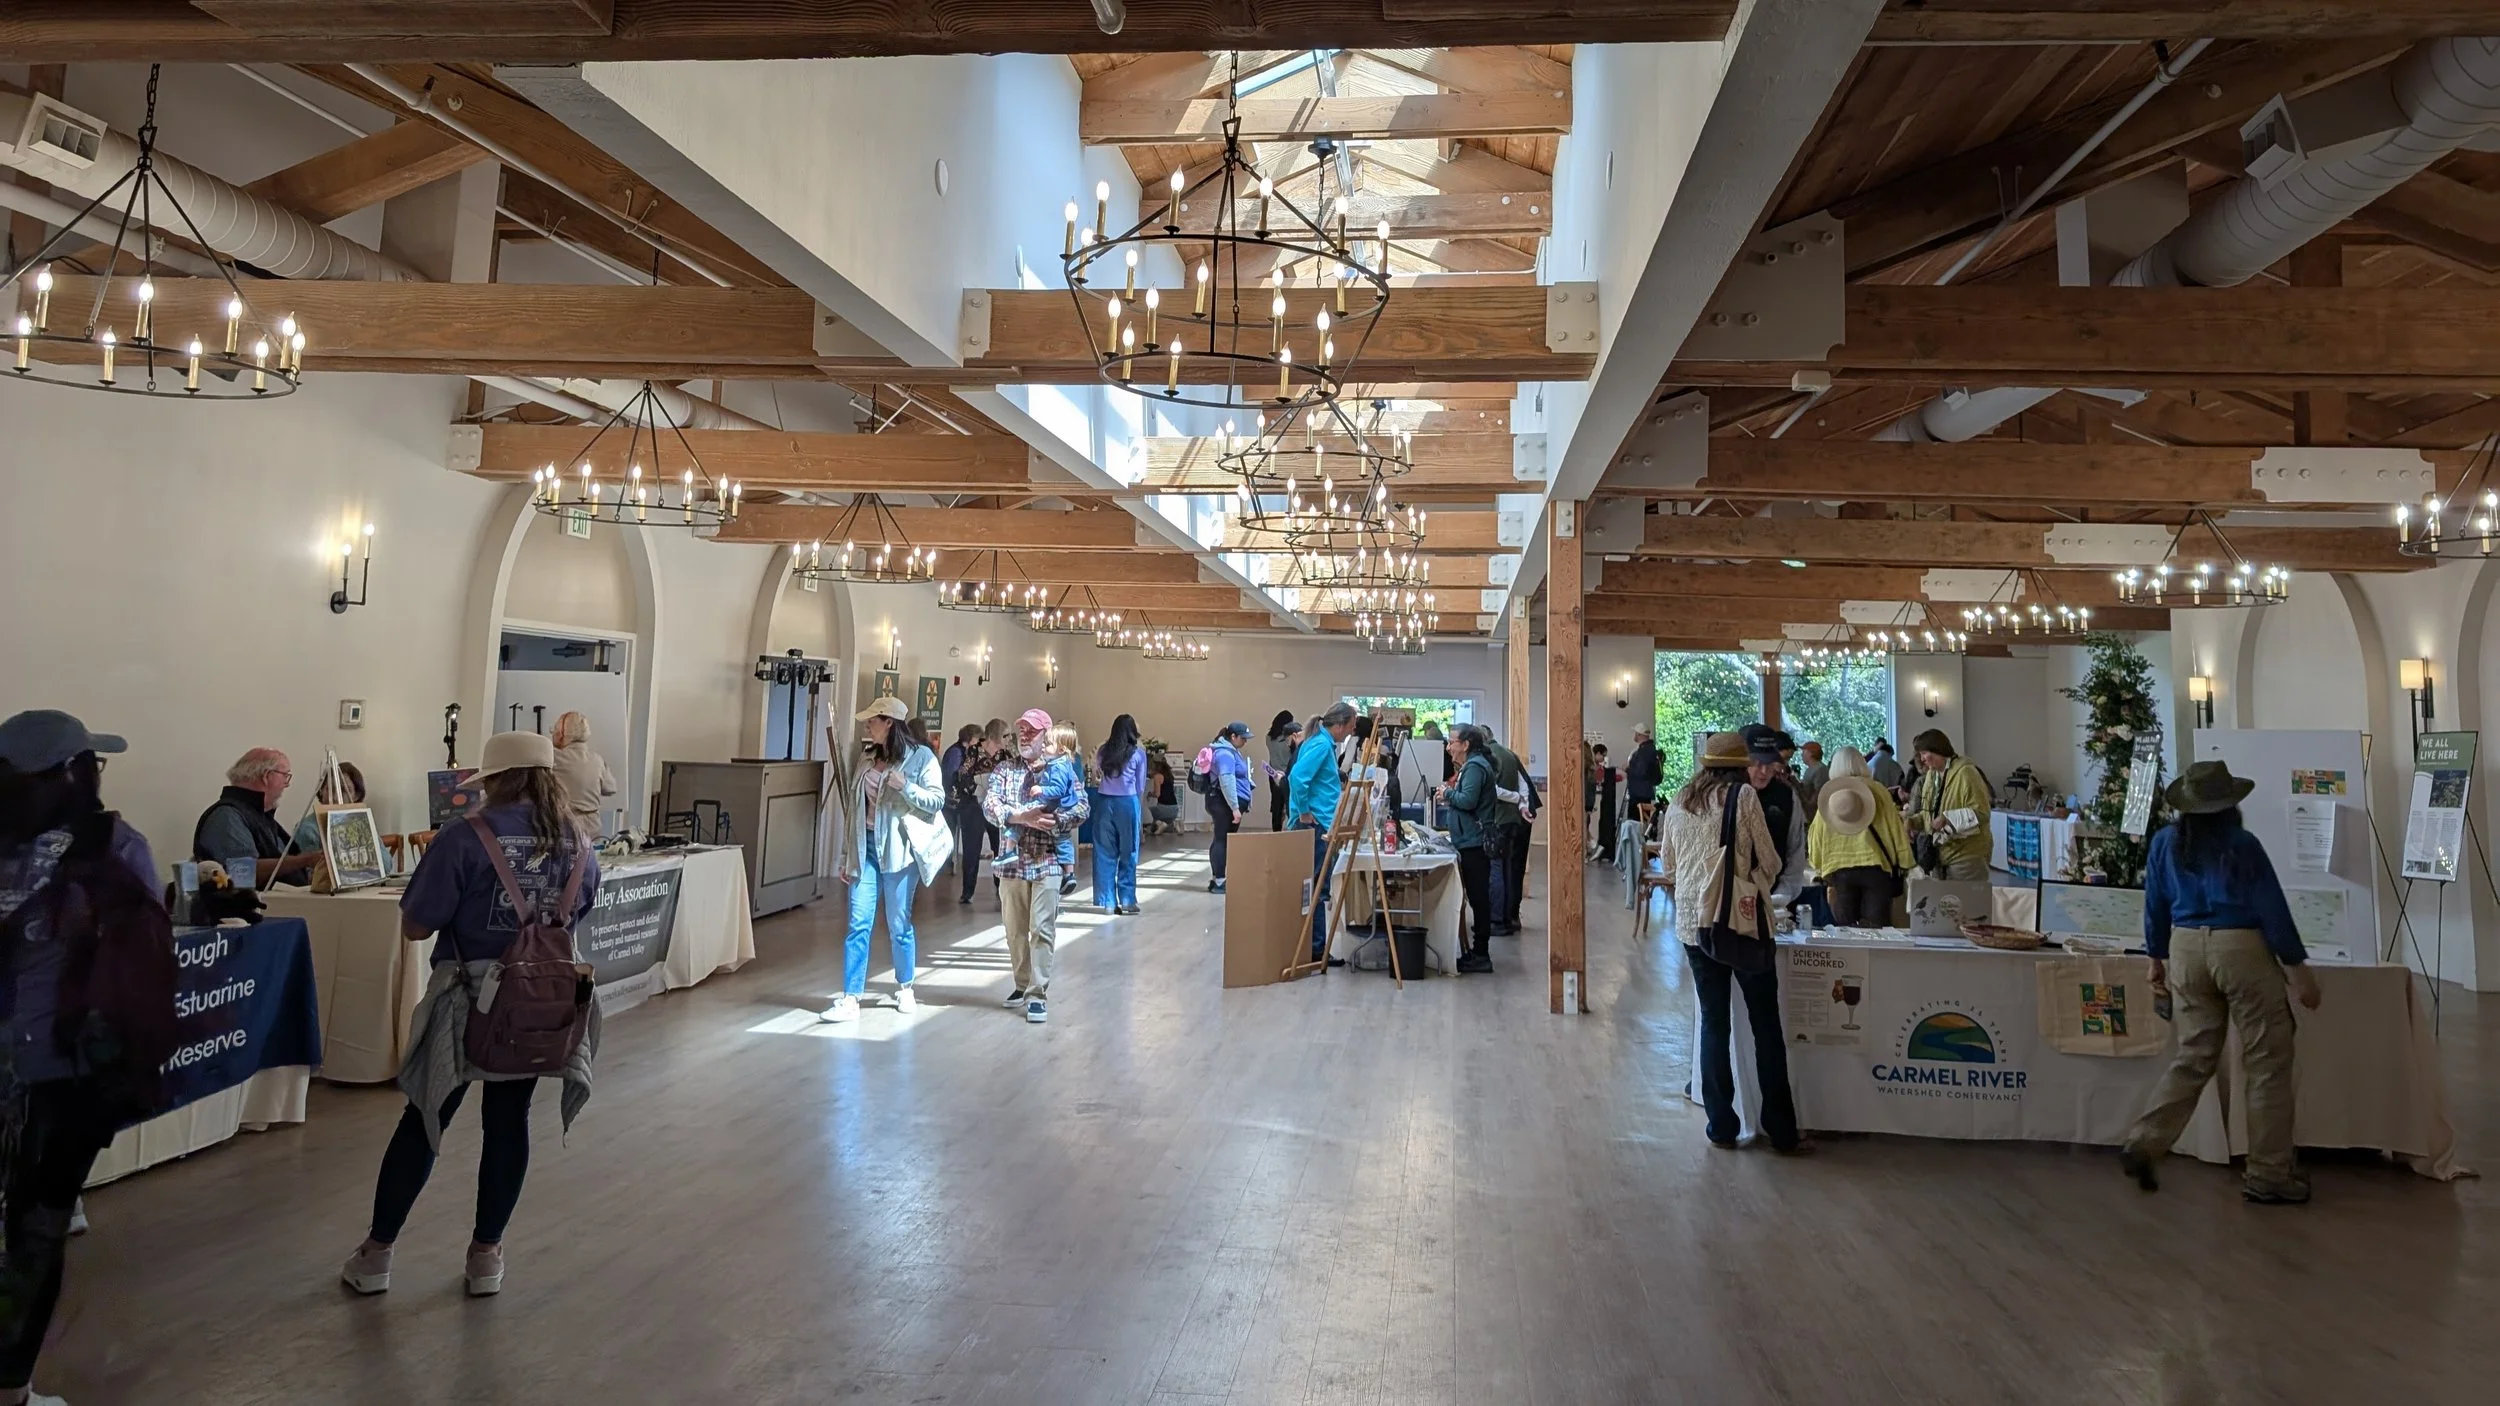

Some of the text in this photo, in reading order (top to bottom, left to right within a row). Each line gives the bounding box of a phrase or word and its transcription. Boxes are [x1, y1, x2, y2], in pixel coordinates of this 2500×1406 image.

[572, 510, 588, 535] EXIT
[2422, 738, 2448, 748] WE ALL
[2420, 750, 2458, 760] LIVE HERE
[616, 879, 668, 904] Association
[590, 926, 598, 937] To
[620, 920, 635, 933] protect
[636, 917, 645, 926] and
[591, 941, 599, 951] the
[615, 934, 623, 944] and
[624, 930, 640, 942] natural
[608, 943, 644, 960] of Carmel Valley
[1793, 950, 1831, 959] SCIENCE
[1793, 958, 1845, 969] UNCORKED
[1895, 1000, 1960, 1058] CELEBRATING
[1872, 1064, 2027, 1089] CARMEL RIVER
[1877, 1086, 1942, 1097] WATERSHED
